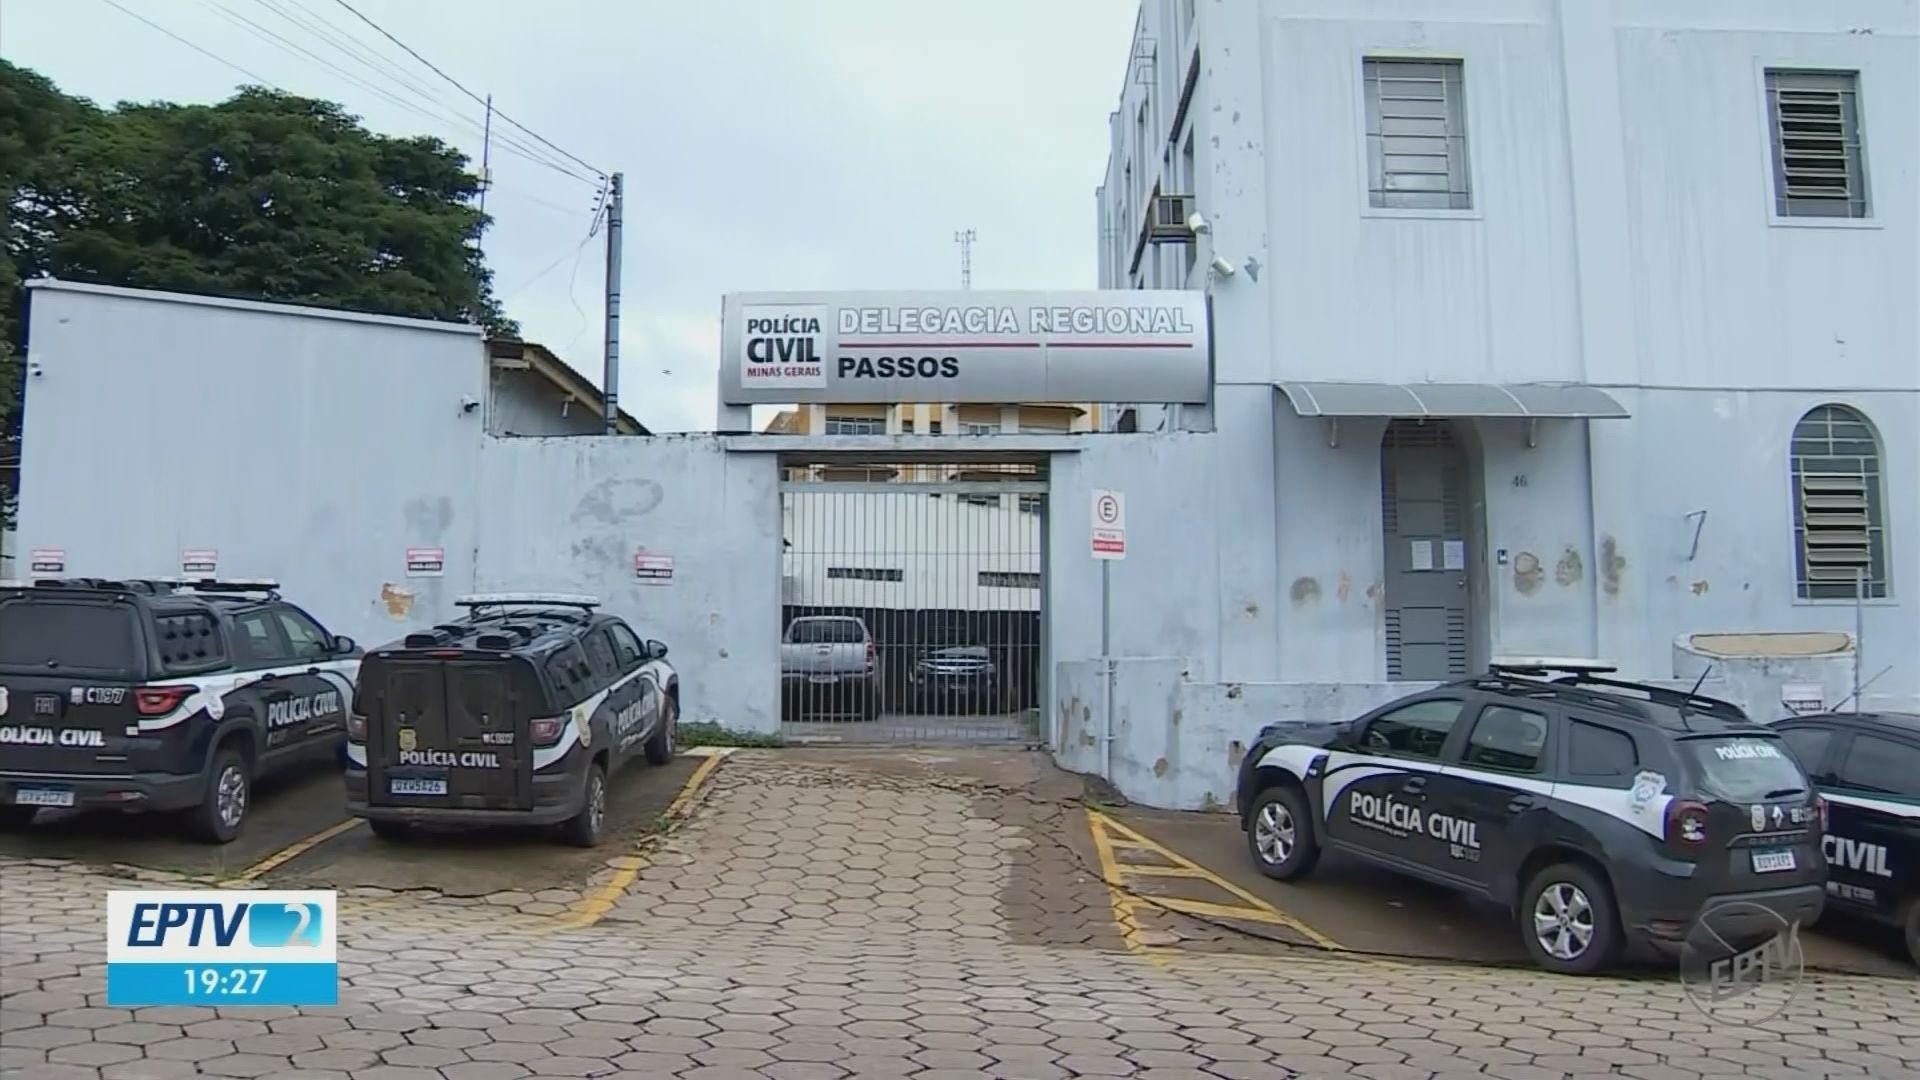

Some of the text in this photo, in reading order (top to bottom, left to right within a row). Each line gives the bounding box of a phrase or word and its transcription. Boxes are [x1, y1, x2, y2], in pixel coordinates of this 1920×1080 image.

[747, 314, 821, 334] POLÍCIA
[838, 307, 1193, 334] DELEGACIA REGIONAL
[747, 338, 821, 363] CIVIL
[747, 367, 821, 378] MINAS GERAIS
[838, 356, 960, 379] PASSOS
[1512, 475, 1528, 488] 46
[1103, 501, 1113, 517] E
[268, 691, 339, 728] POLÍCIA CIVIL
[0, 724, 107, 746] OLÍCIA CIVIL
[400, 749, 500, 768] POLÍCIA CIVIL
[1351, 791, 1424, 833] POLÍCIA
[1428, 813, 1481, 848] CIVIL
[1821, 834, 1892, 878] CIVIL
